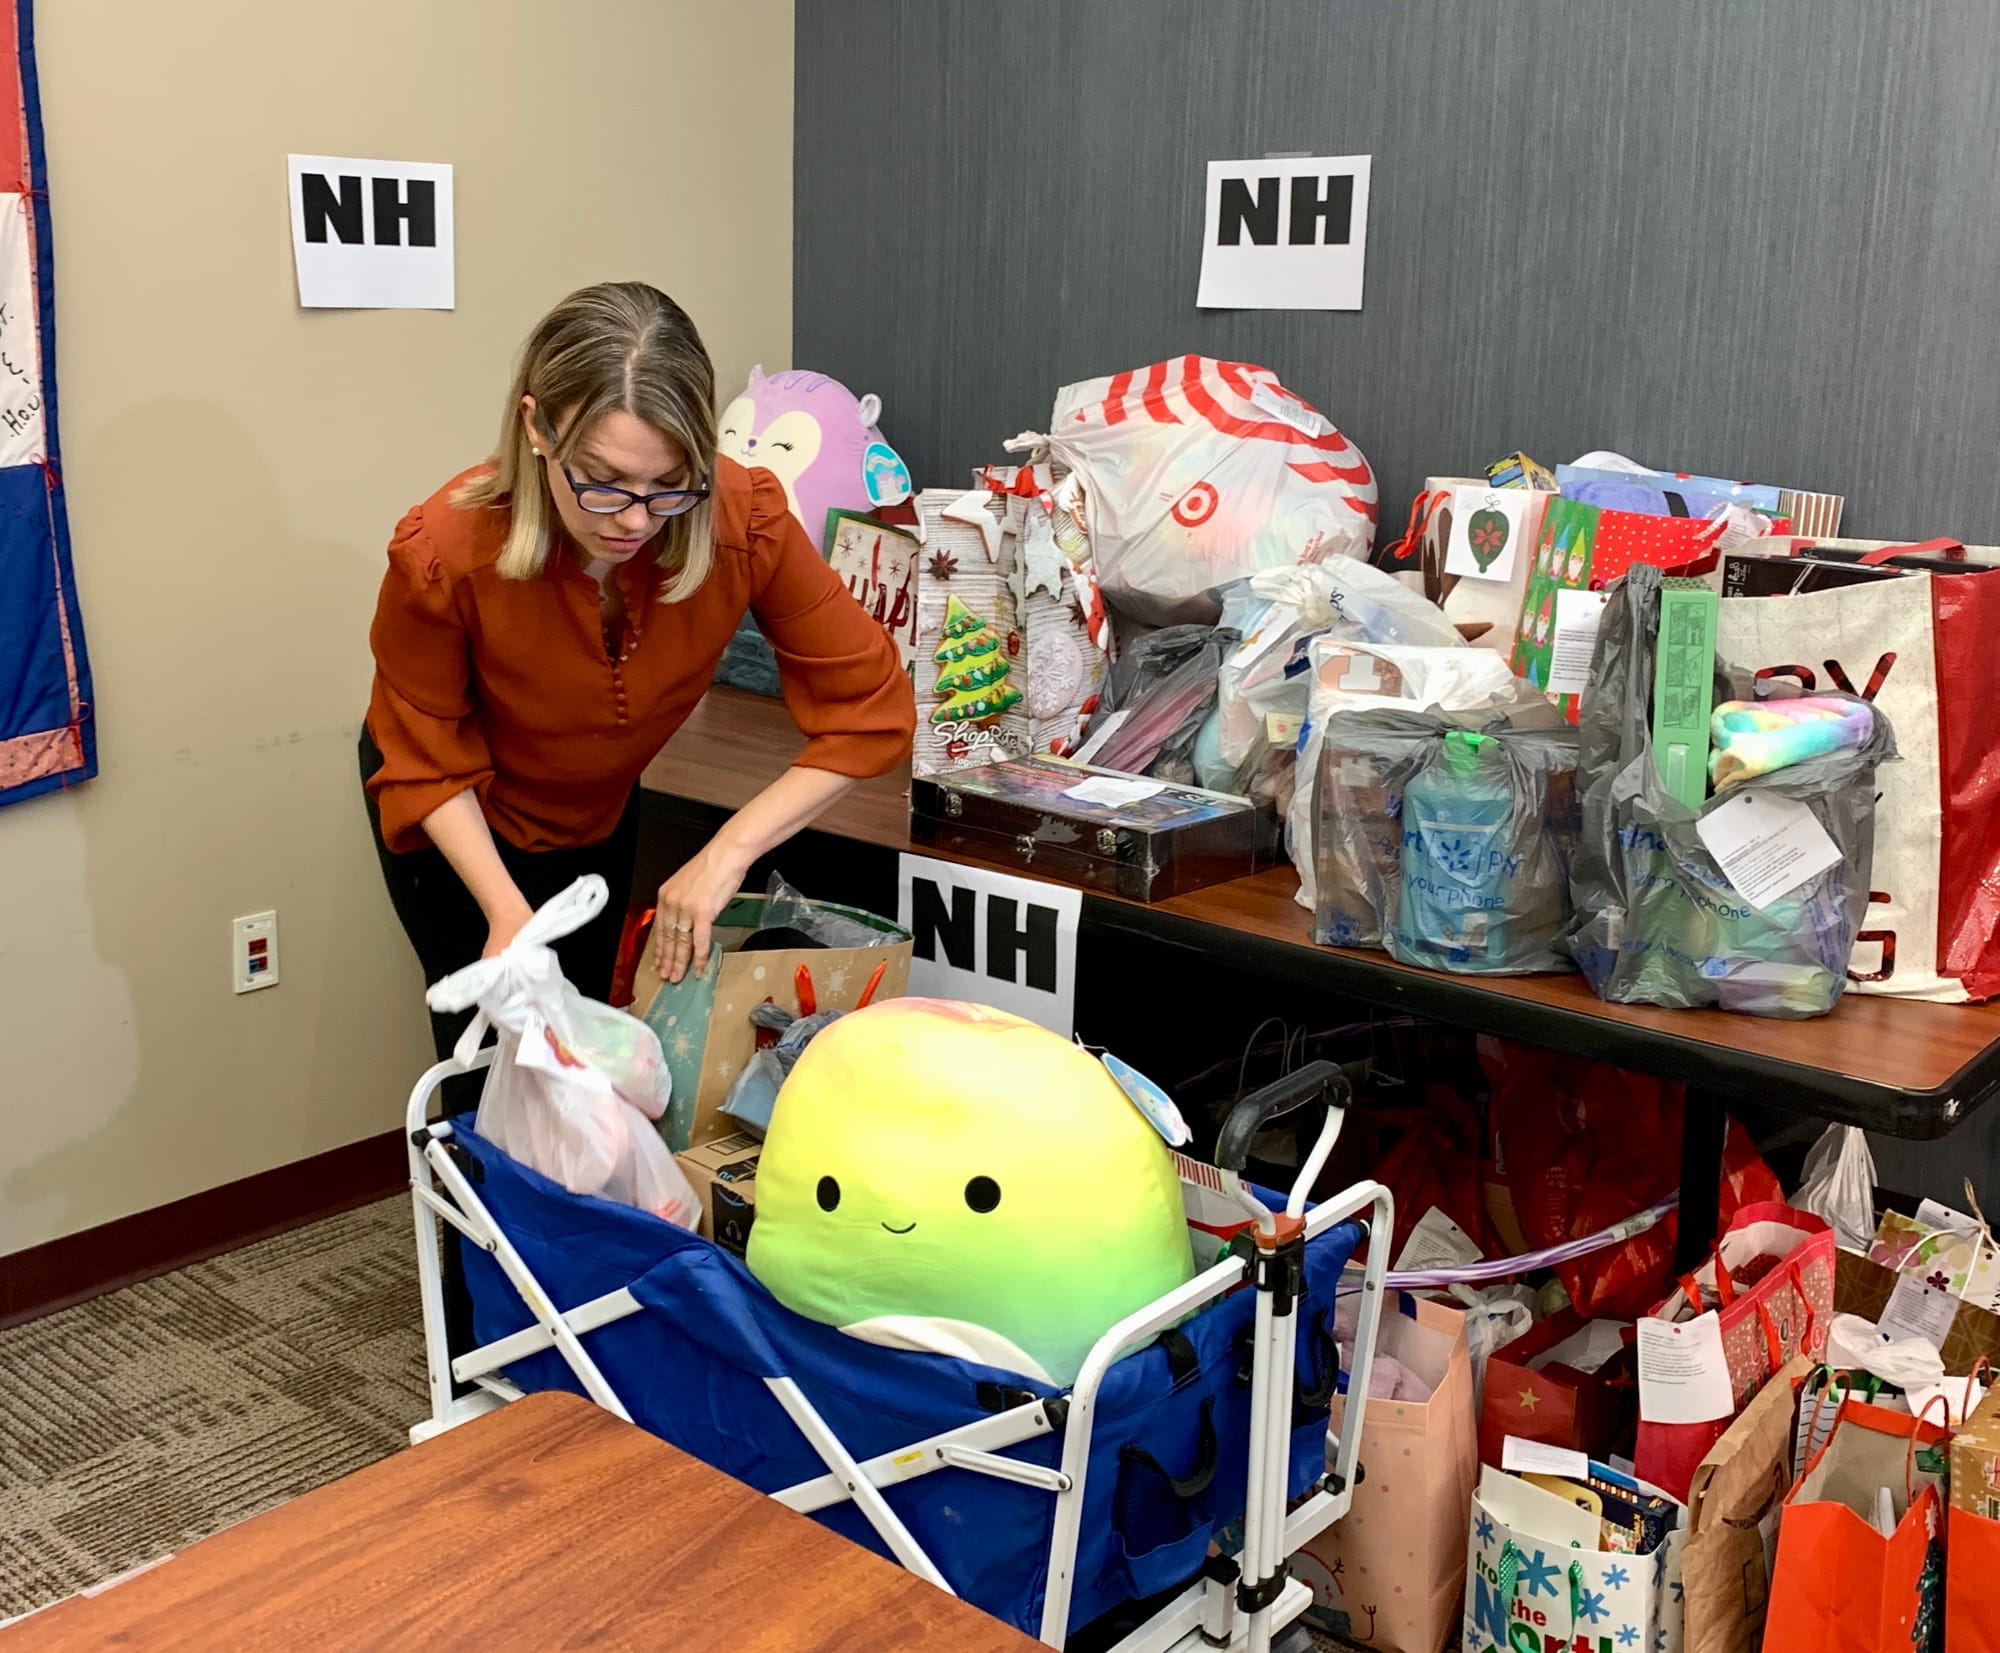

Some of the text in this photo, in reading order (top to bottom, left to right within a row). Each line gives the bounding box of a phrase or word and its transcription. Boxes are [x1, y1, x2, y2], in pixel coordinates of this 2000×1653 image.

[301, 173, 436, 247] NH
[1217, 174, 1354, 246] NH
[930, 721, 1019, 751] ShopRite
[1446, 887, 1505, 910] phone
[911, 875, 1060, 995] NH
[1511, 1598, 1548, 1628] the
